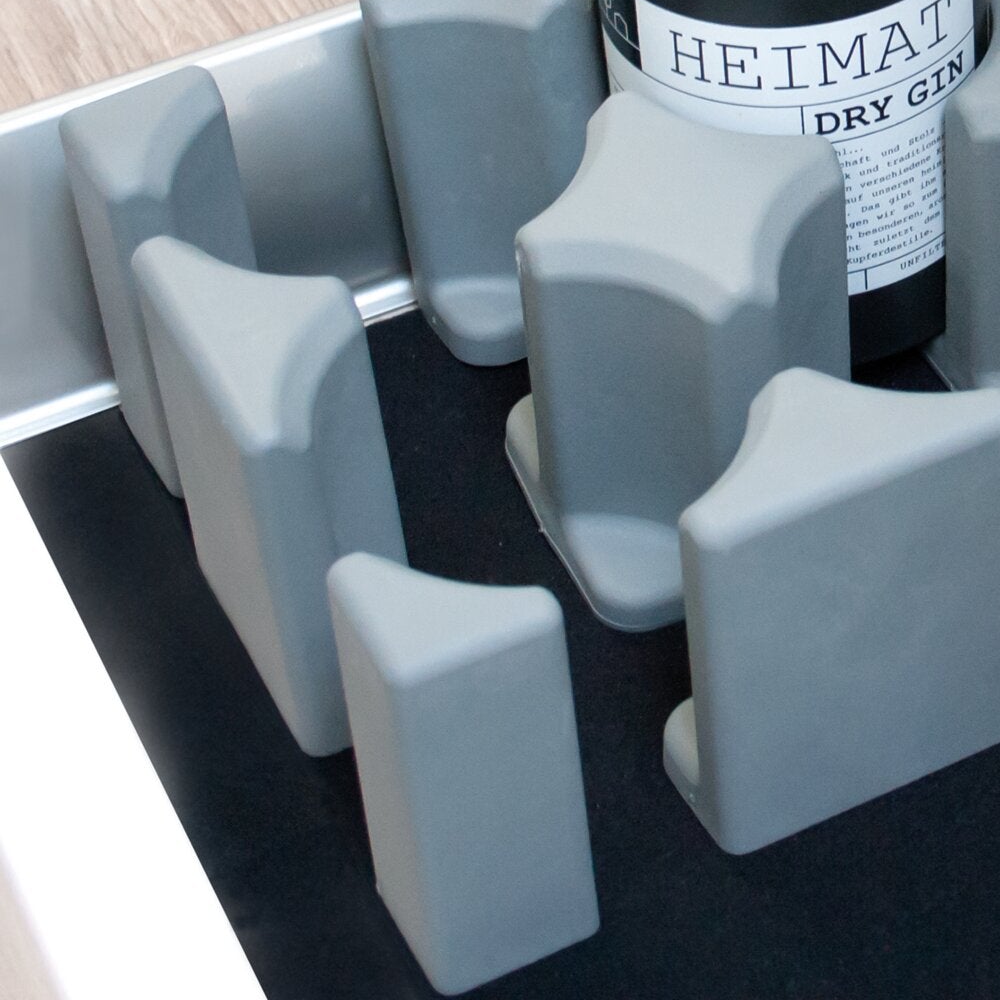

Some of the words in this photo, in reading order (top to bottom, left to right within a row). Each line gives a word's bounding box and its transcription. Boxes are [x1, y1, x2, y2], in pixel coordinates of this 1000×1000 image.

[815, 95, 893, 136] DRY
[908, 51, 964, 107] GIN
[881, 144, 900, 158] und
[859, 164, 879, 177] und
[860, 155, 931, 189] verschiedene
[872, 176, 915, 198] unseren
[861, 203, 880, 213] Das
[889, 190, 912, 206] gibt
[877, 209, 895, 220] wir
[903, 201, 915, 210] so
[873, 226, 913, 246] zuletzt
